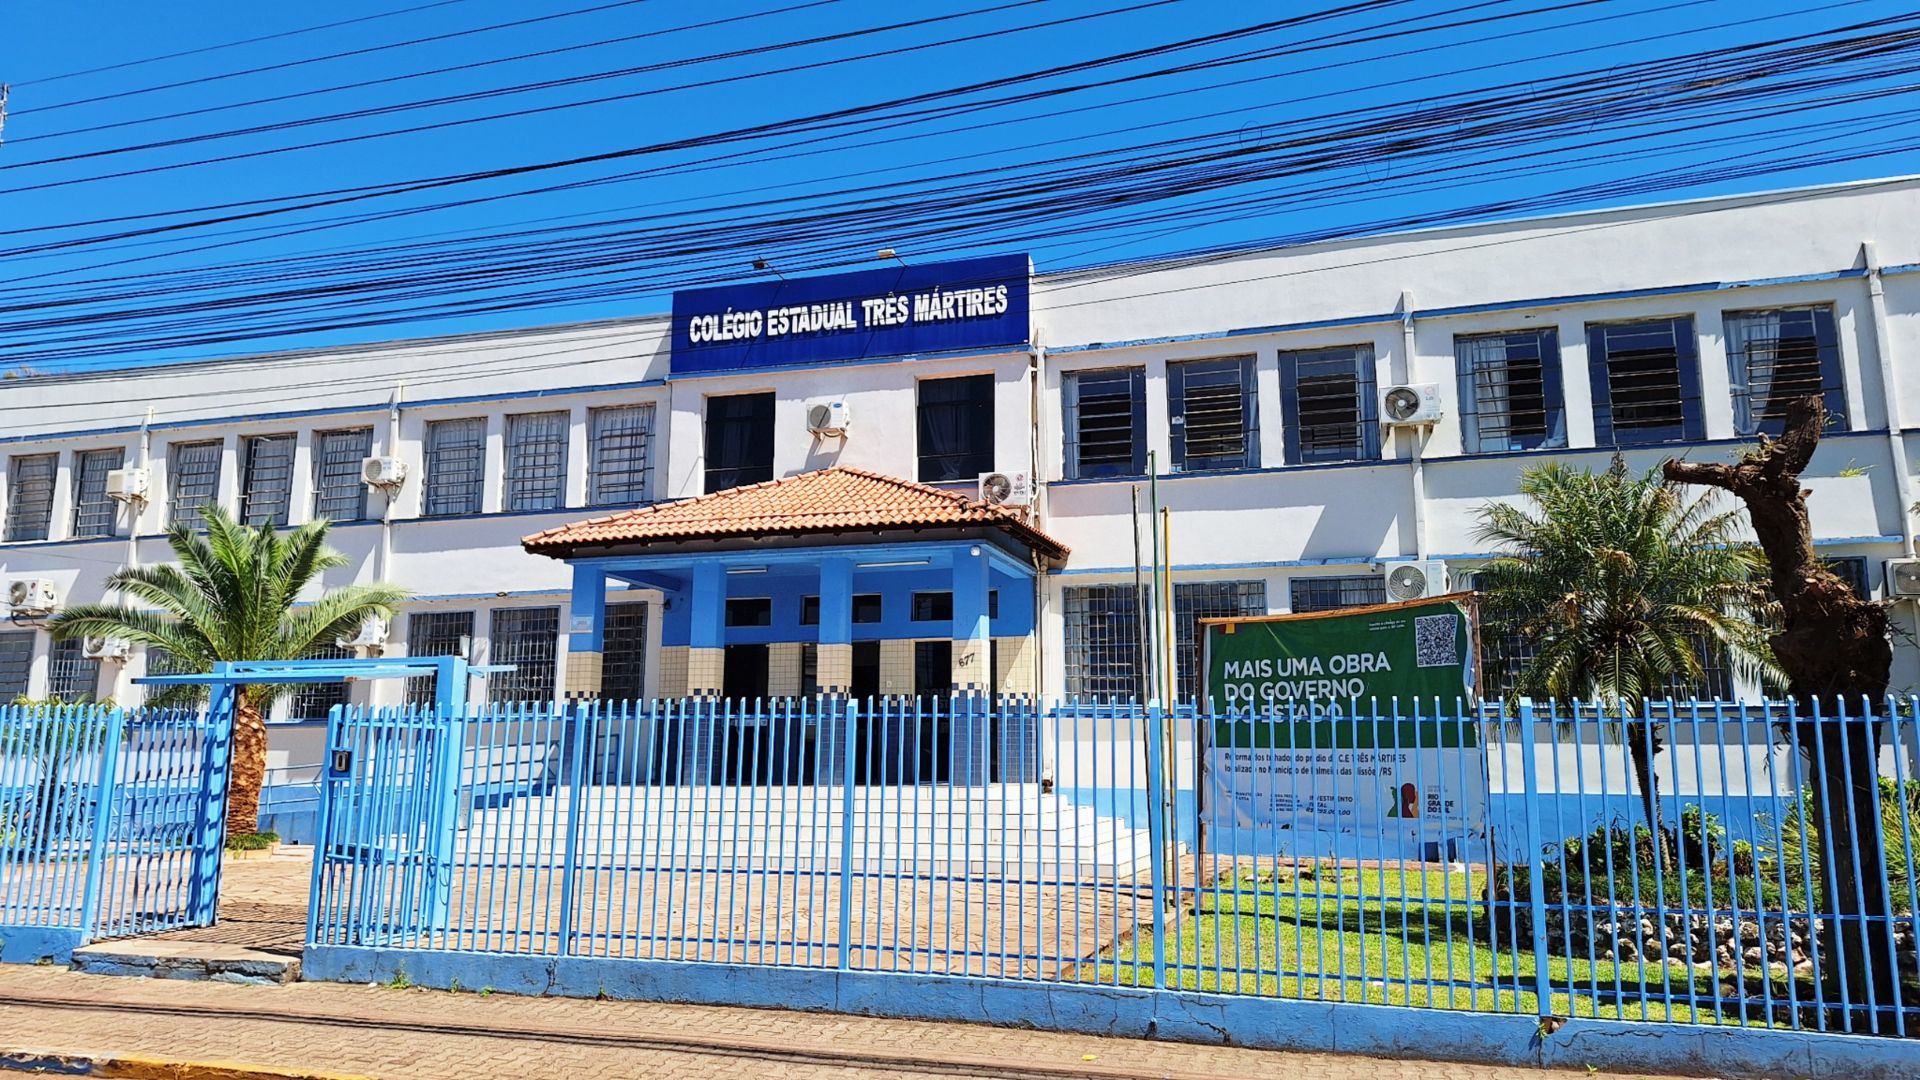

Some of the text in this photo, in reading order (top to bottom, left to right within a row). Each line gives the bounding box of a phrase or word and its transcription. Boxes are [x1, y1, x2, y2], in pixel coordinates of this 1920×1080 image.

[690, 285, 1008, 342] COLÉGIO ESTADUAL TRÊS MÁRTIRES
[958, 652, 975, 667] 677
[1224, 651, 1392, 679] MAIS UMA OBRA
[1224, 678, 1365, 701] DO GOVERNO
